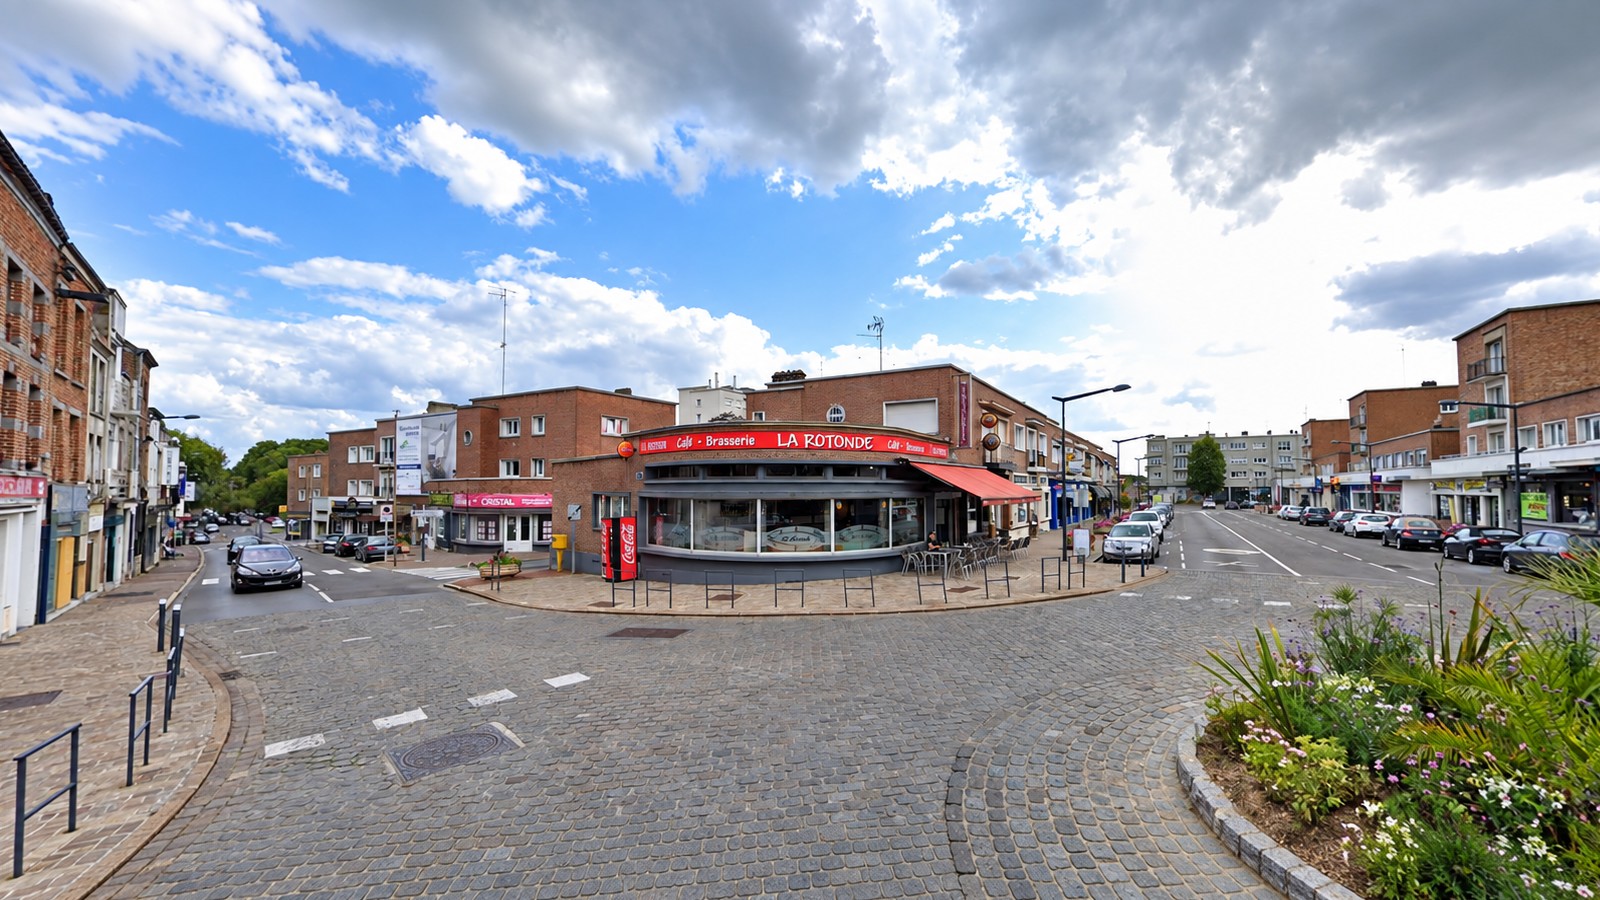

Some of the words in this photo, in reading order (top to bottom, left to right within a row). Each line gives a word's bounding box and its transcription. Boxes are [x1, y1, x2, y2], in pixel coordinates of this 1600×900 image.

[706, 434, 755, 447] Brasserie
[777, 433, 798, 448] LA
[804, 434, 874, 450] ROTONDE
